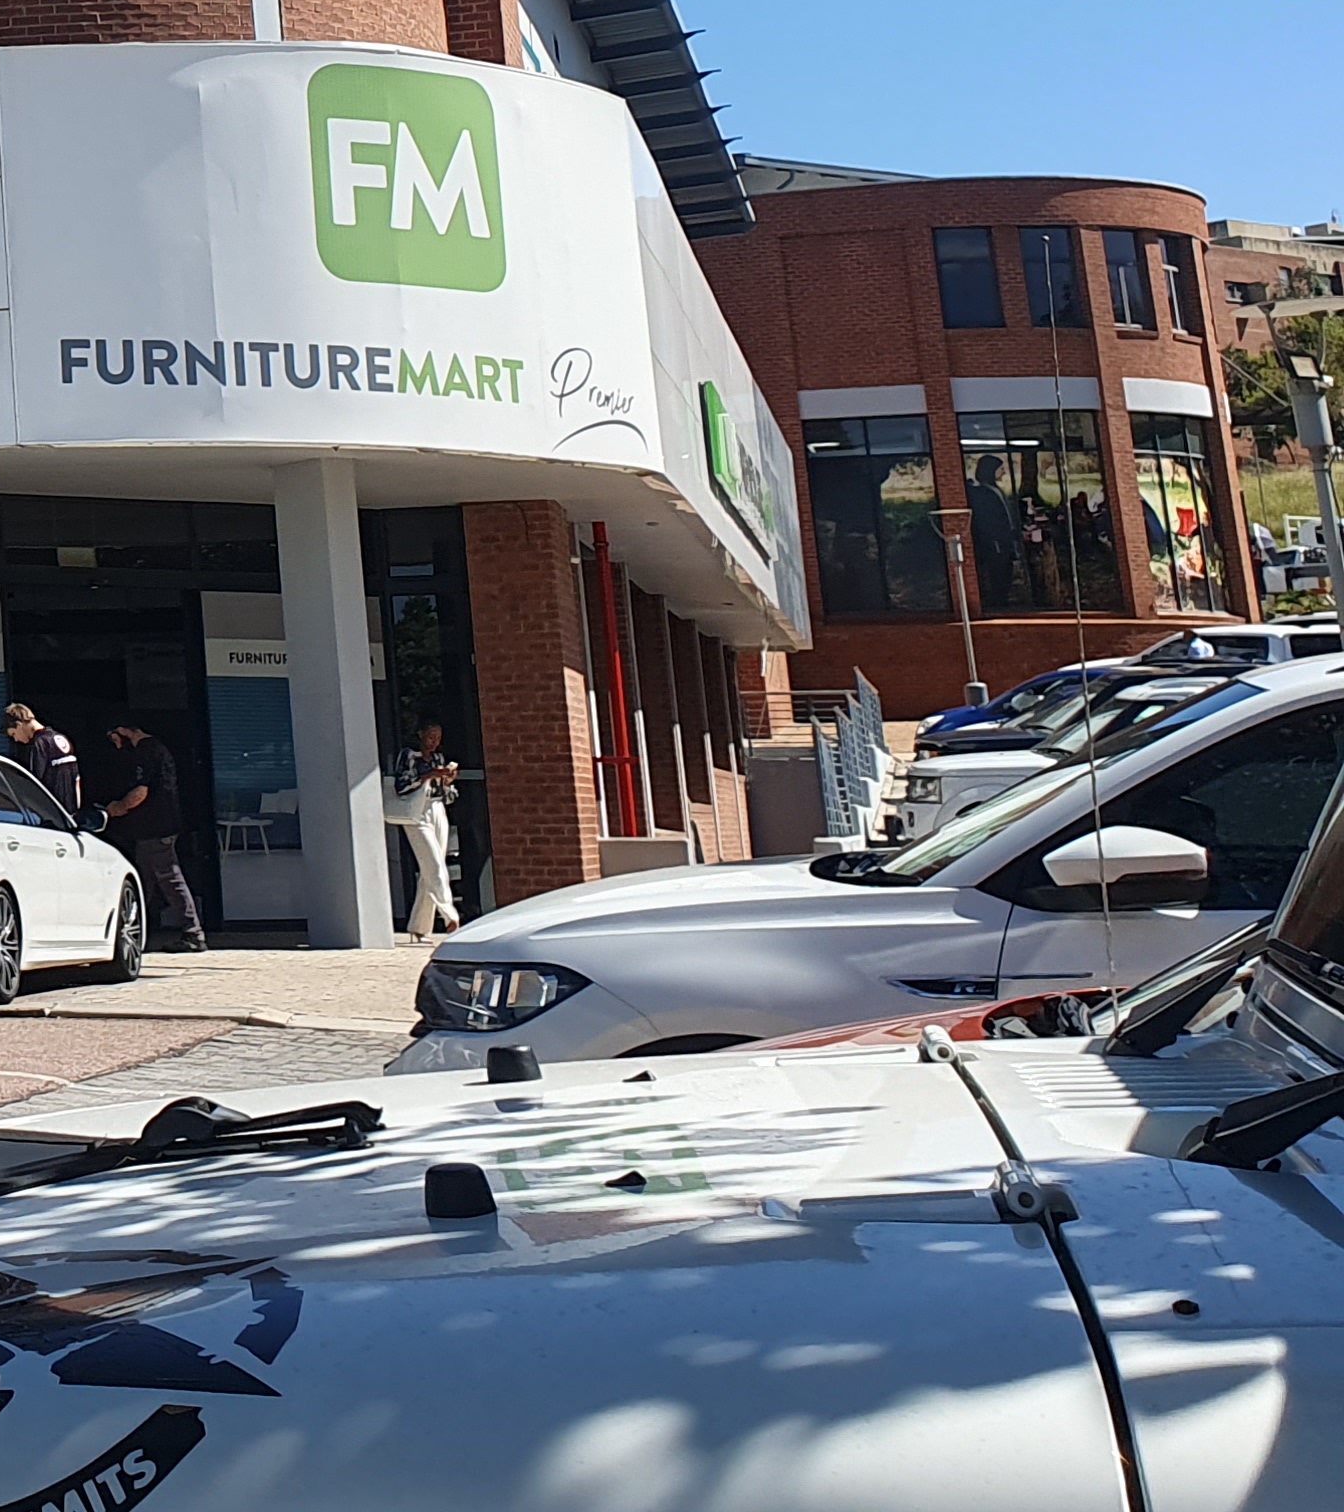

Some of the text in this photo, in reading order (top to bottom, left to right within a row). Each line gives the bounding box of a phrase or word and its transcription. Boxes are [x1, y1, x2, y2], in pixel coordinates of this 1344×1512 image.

[327, 118, 492, 239] FM
[59, 338, 636, 418] FURNITUREMART Premier
